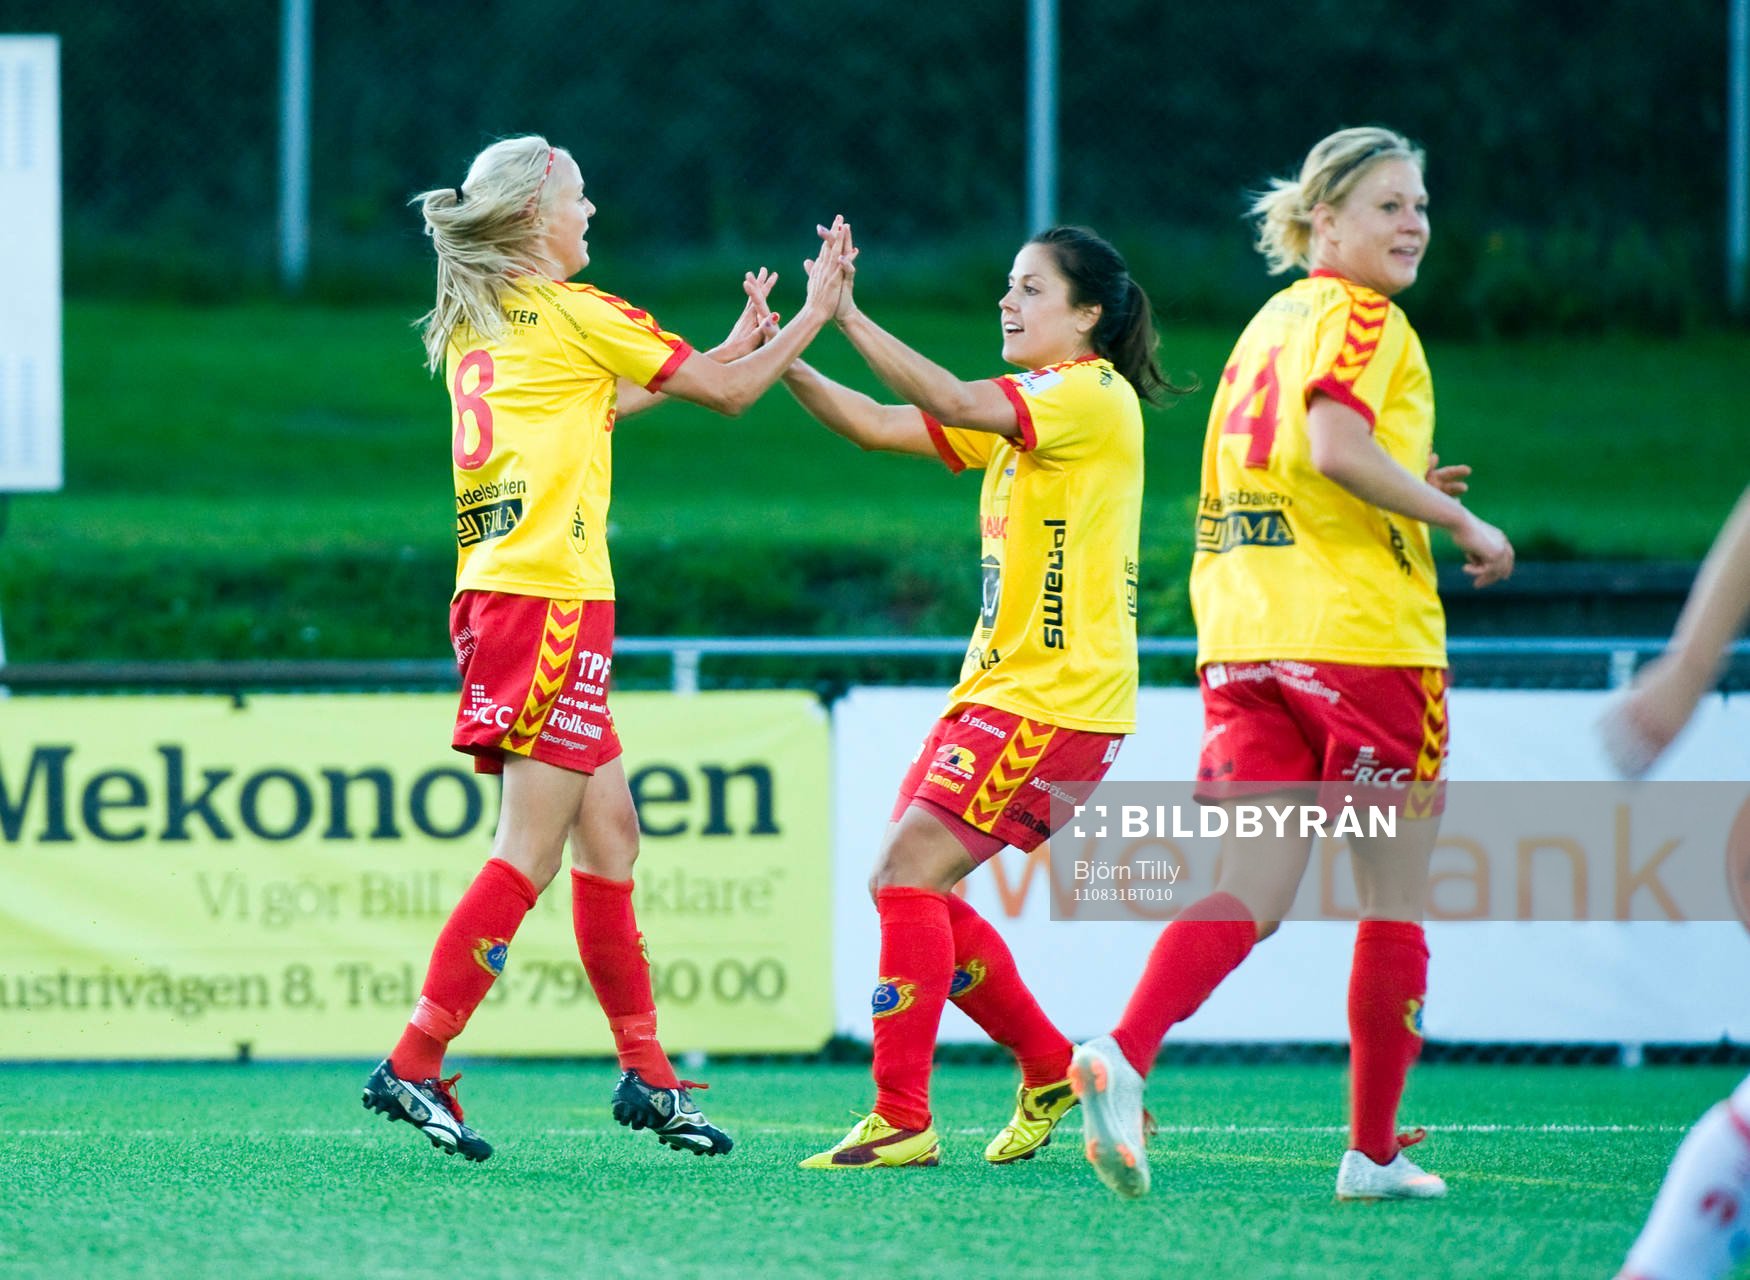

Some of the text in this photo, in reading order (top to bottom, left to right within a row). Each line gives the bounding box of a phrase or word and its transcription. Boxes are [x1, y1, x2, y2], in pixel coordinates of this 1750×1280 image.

[454, 349, 494, 471] 8
[0, 743, 783, 842] Mekonoen
[1353, 766, 1412, 789] RCC
